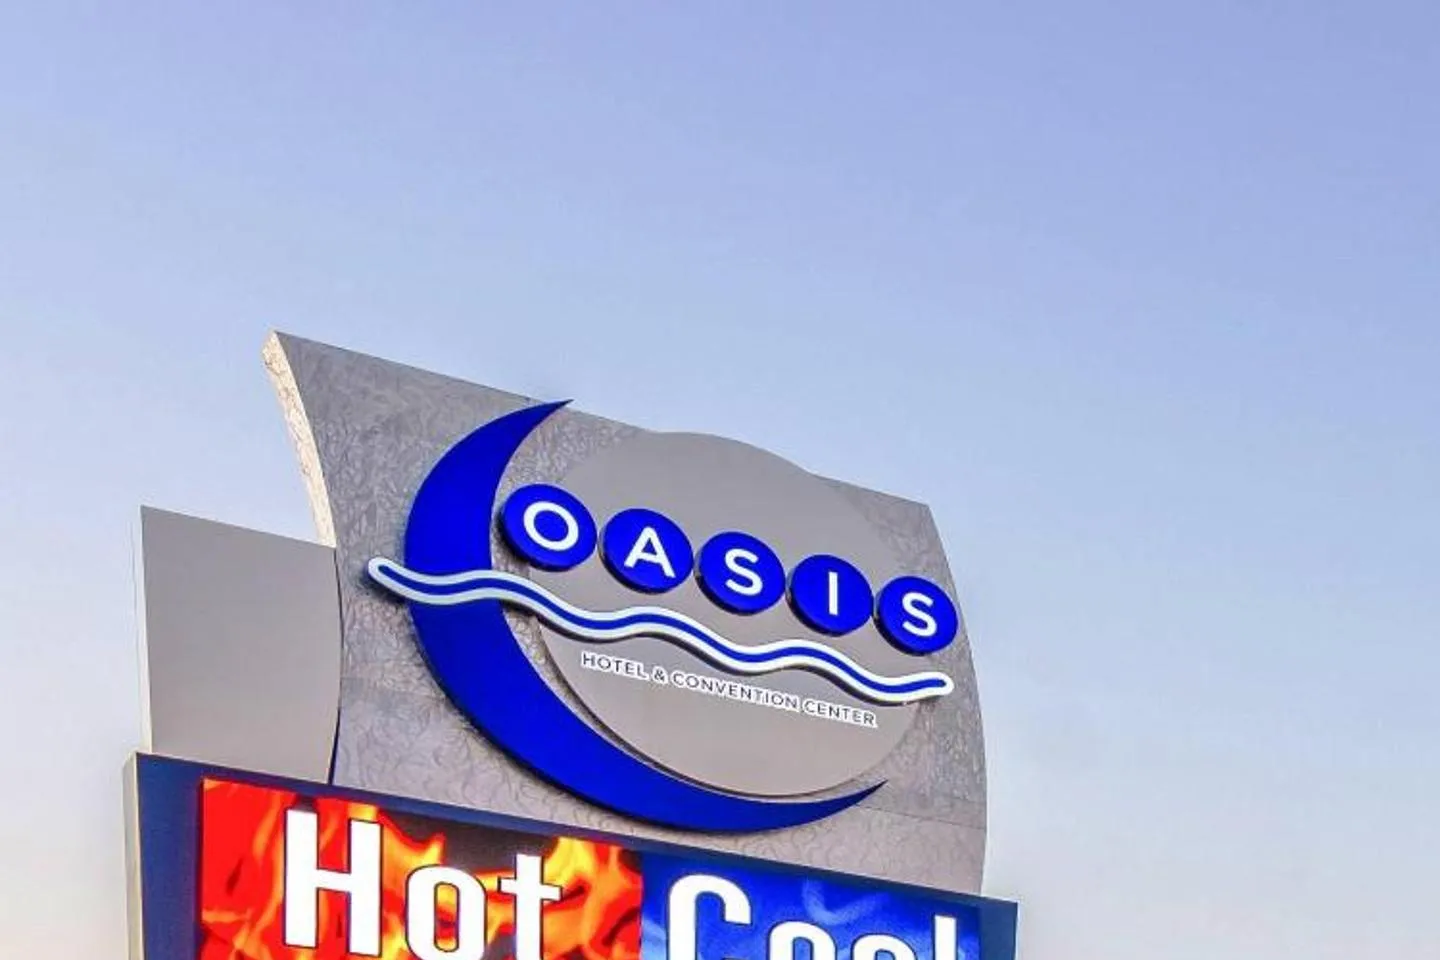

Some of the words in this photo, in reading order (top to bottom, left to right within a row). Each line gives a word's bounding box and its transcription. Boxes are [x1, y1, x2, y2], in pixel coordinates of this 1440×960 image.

[521, 500, 940, 640] OASIS
[581, 651, 649, 680] HOTEL
[652, 665, 669, 685] &
[672, 670, 799, 712] CONVENTION
[803, 698, 878, 728] CENTER
